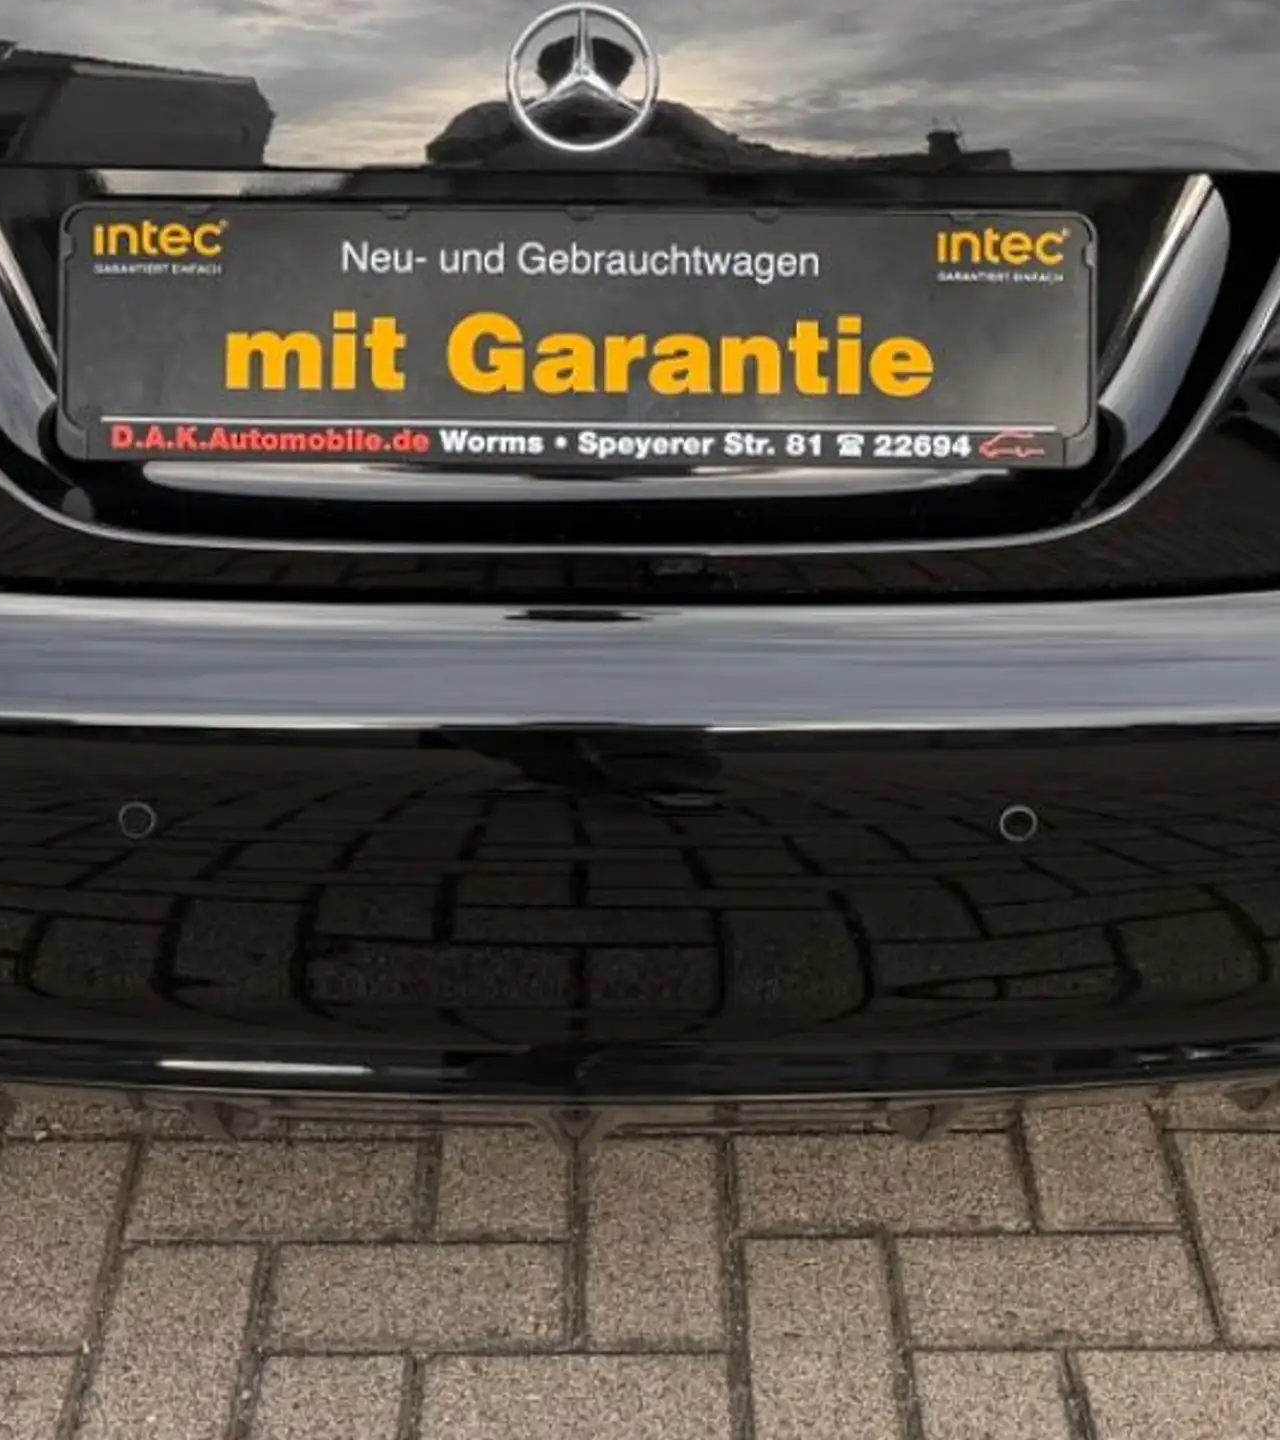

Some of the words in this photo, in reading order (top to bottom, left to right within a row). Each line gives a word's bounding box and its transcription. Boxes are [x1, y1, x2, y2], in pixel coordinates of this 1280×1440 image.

[341, 240, 427, 274] Neu-
[438, 241, 506, 275] und
[517, 240, 820, 286] Gebrauchtwagen
[225, 310, 407, 391] mit
[446, 311, 935, 398] Garantie
[439, 429, 544, 454] Worms
[577, 431, 715, 459] Speyerer
[723, 432, 776, 456] Str.
[785, 433, 822, 457] 81
[873, 434, 972, 458] 22694
